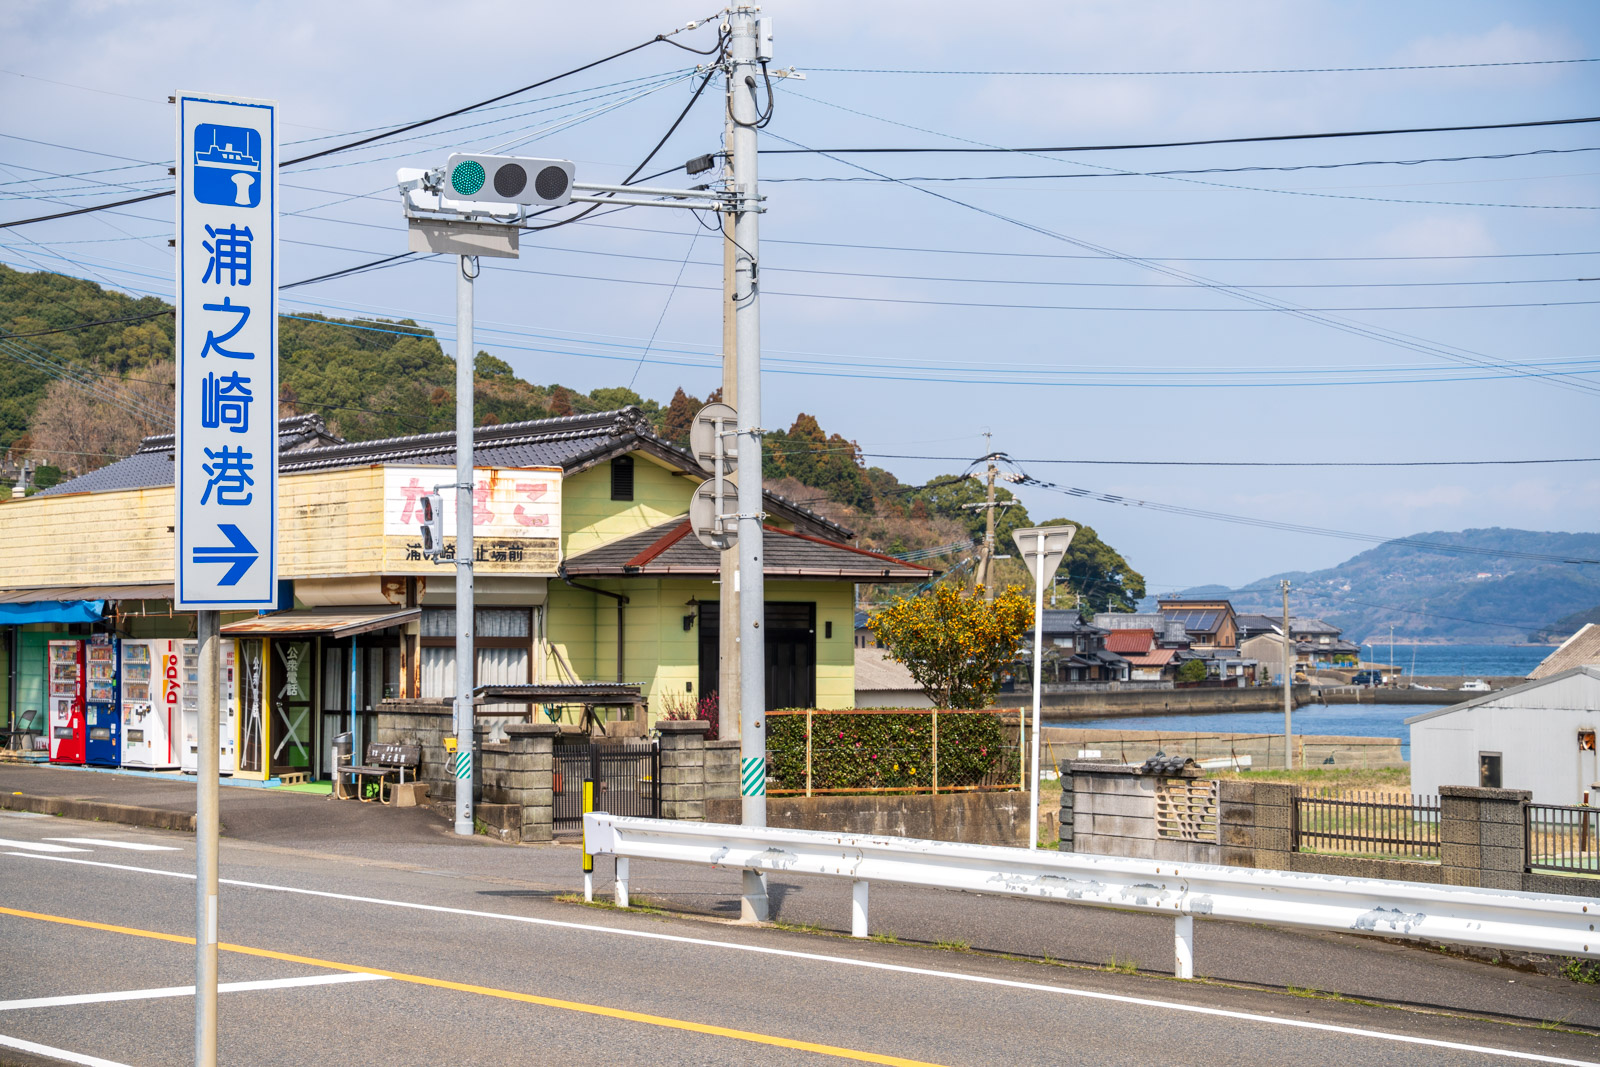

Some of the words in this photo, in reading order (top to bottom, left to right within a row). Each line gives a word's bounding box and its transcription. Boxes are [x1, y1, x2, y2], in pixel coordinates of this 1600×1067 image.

[200, 223, 255, 506] 浦之崎港
[400, 477, 549, 527] たばこ
[405, 543, 523, 562] 浦崎止場前
[167, 654, 181, 704] DyDo
[286, 646, 299, 696] 公衆電話
